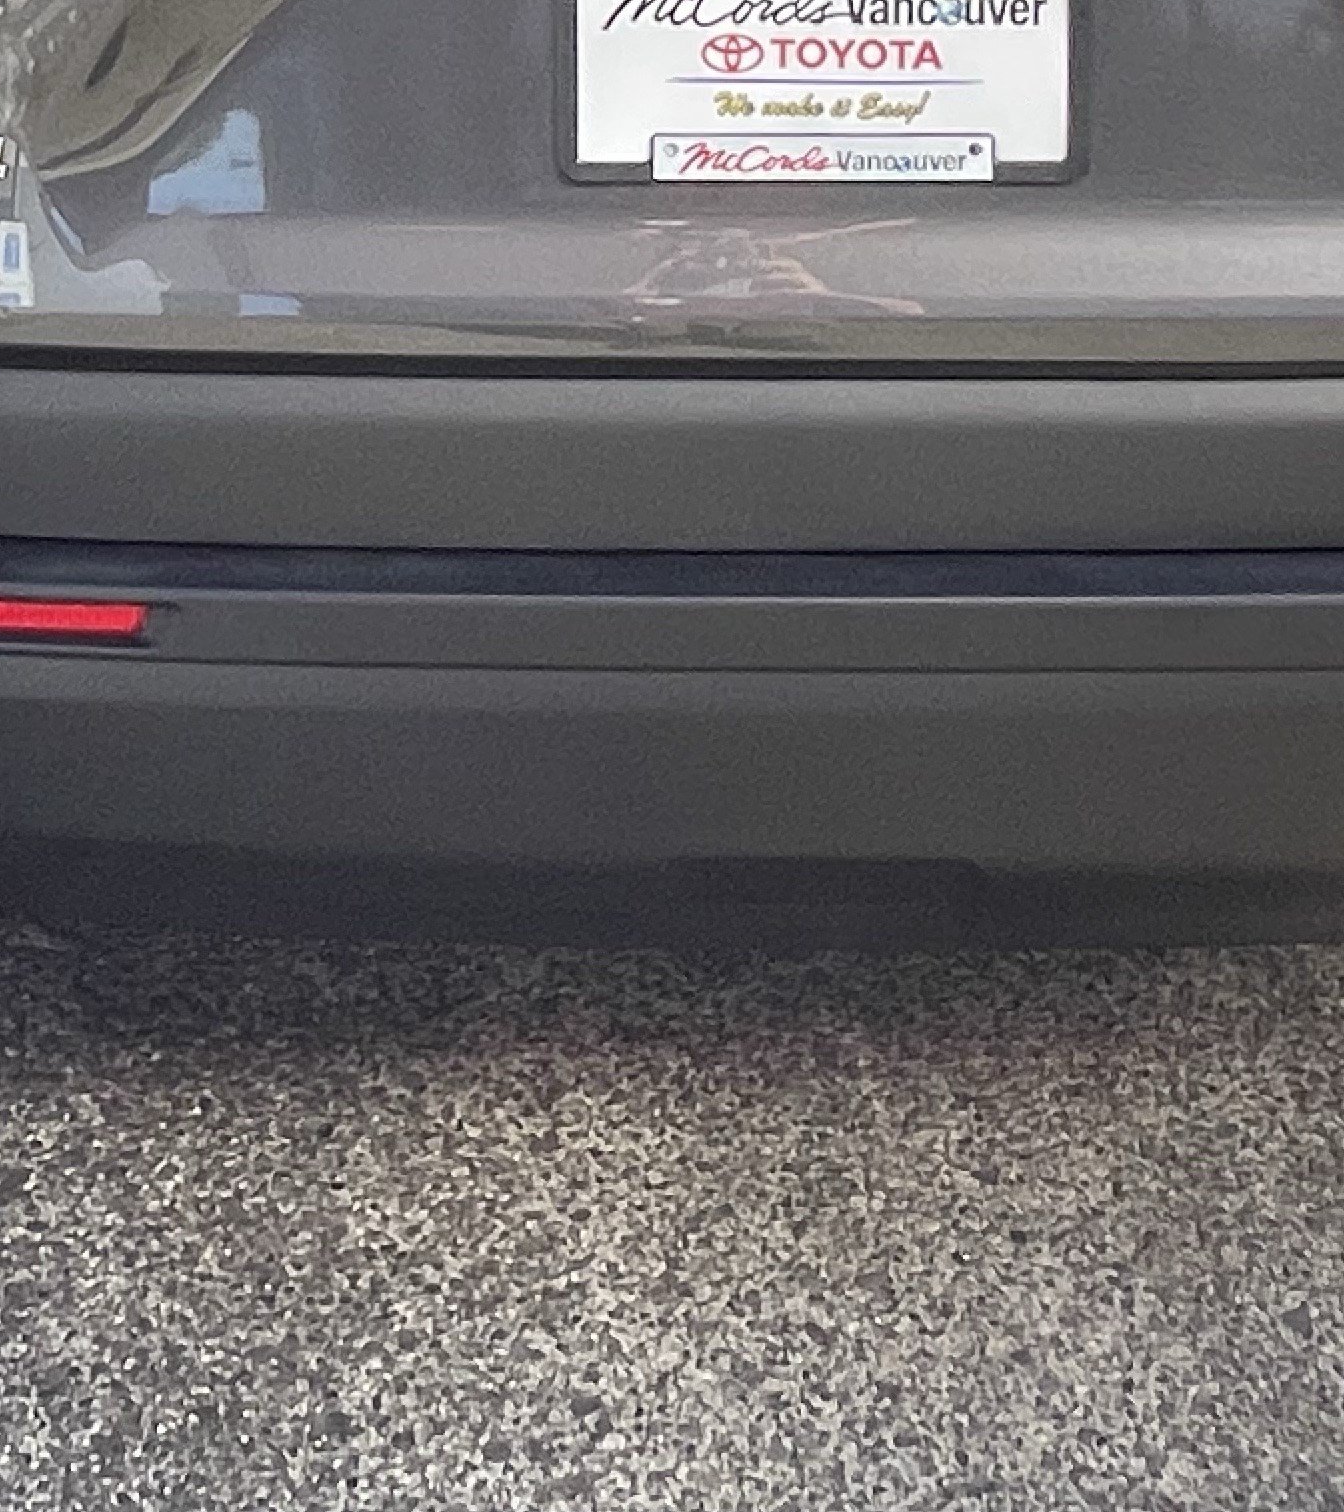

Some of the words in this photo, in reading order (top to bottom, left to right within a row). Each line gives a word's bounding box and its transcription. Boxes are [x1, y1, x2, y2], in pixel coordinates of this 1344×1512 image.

[770, 38, 943, 70] TOYOTA
[760, 92, 824, 118] make
[679, 142, 834, 175] McCords
[836, 149, 968, 173] Vancouver
